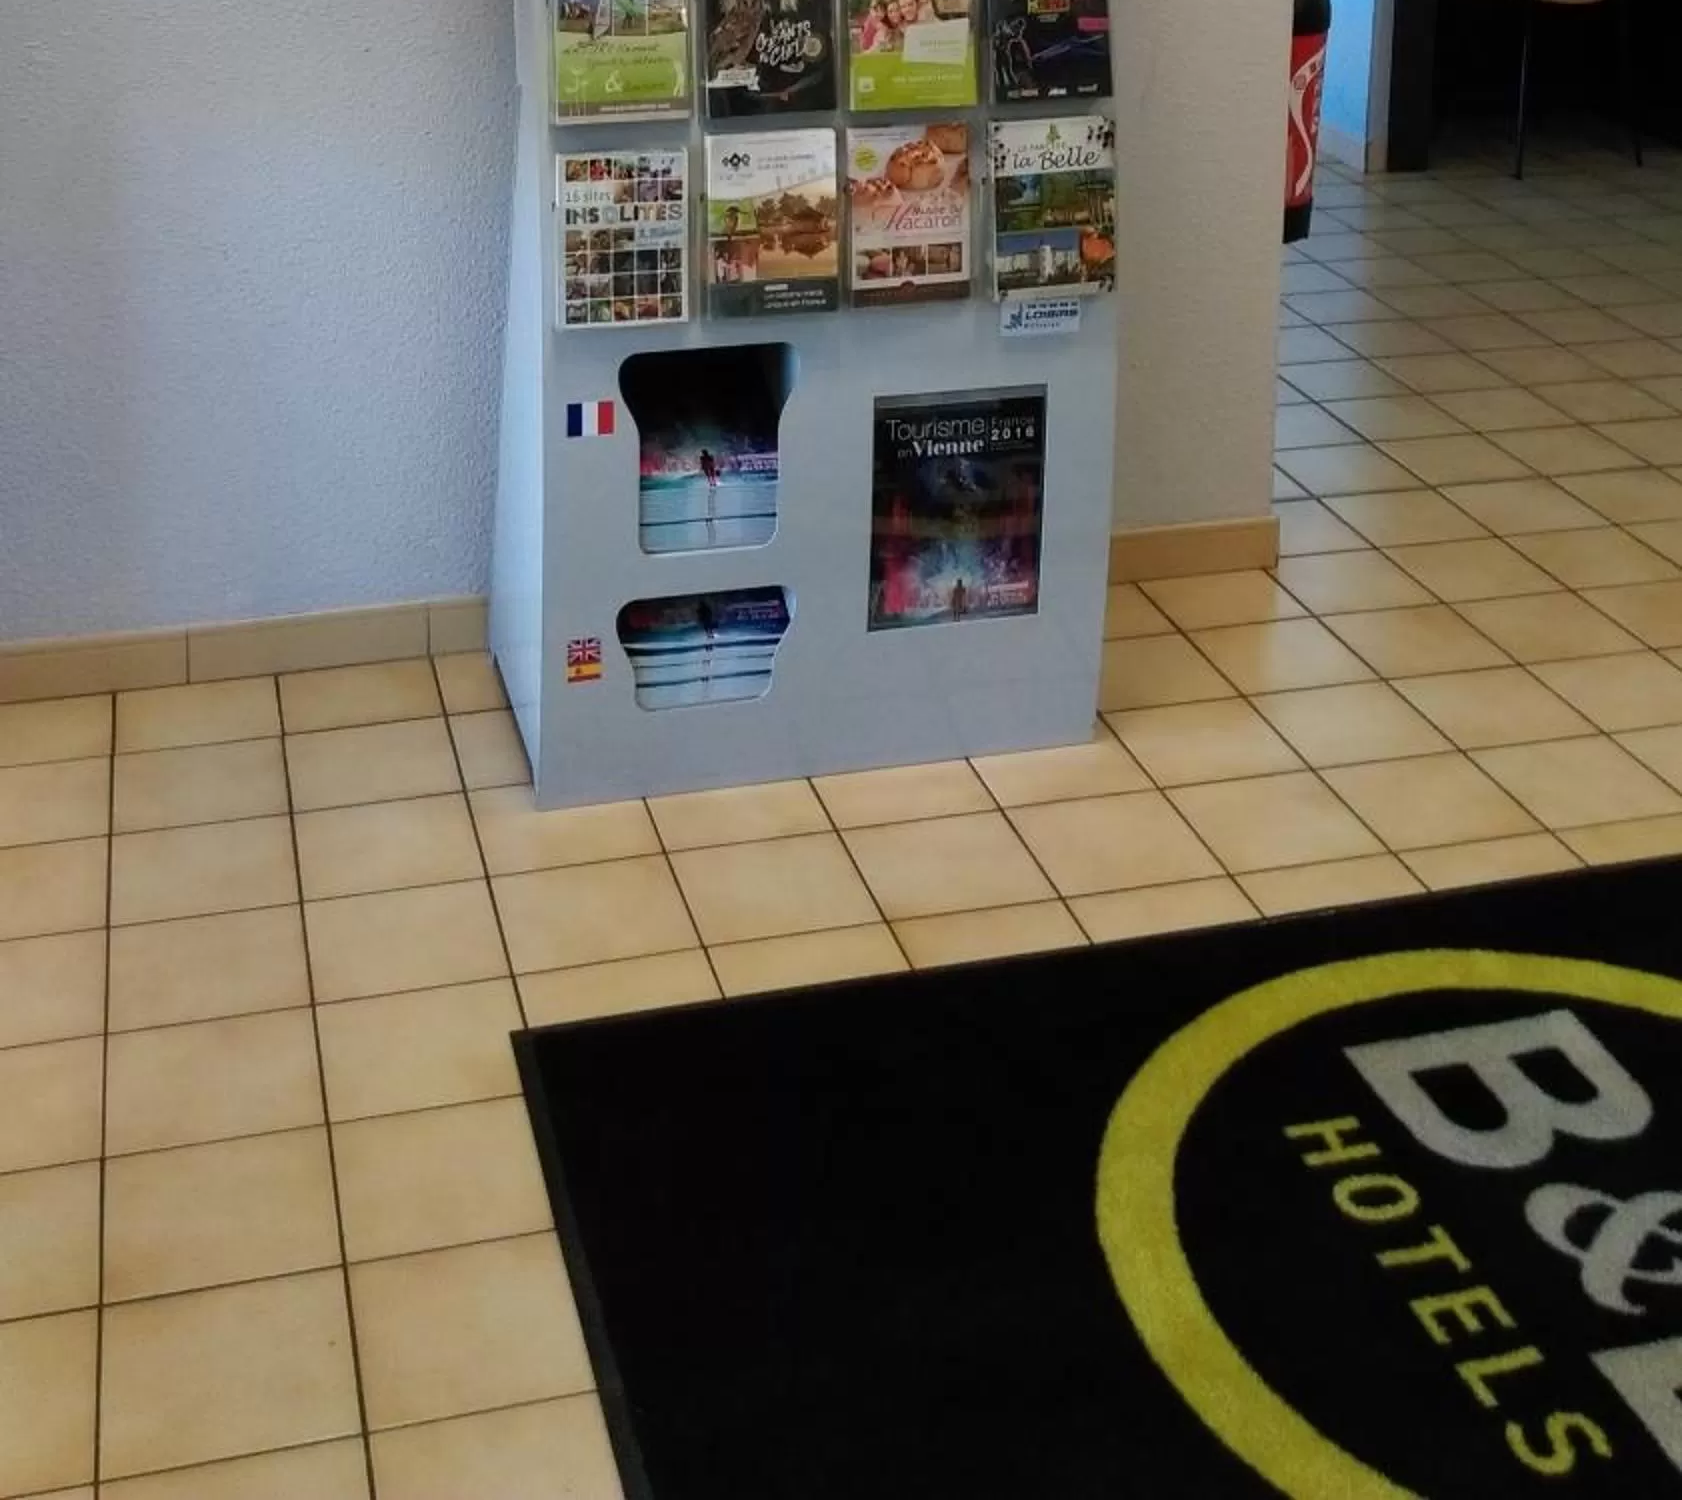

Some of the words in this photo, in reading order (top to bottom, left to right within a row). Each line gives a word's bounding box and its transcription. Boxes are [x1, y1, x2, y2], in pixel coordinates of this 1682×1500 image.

[1038, 146, 1101, 171] Belle
[565, 204, 683, 225] INSOLITES
[886, 417, 985, 441] Tourisme
[912, 438, 984, 457] Vienne
[1342, 1008, 1682, 1473] B&
[1283, 1115, 1613, 1476] HOTELS
